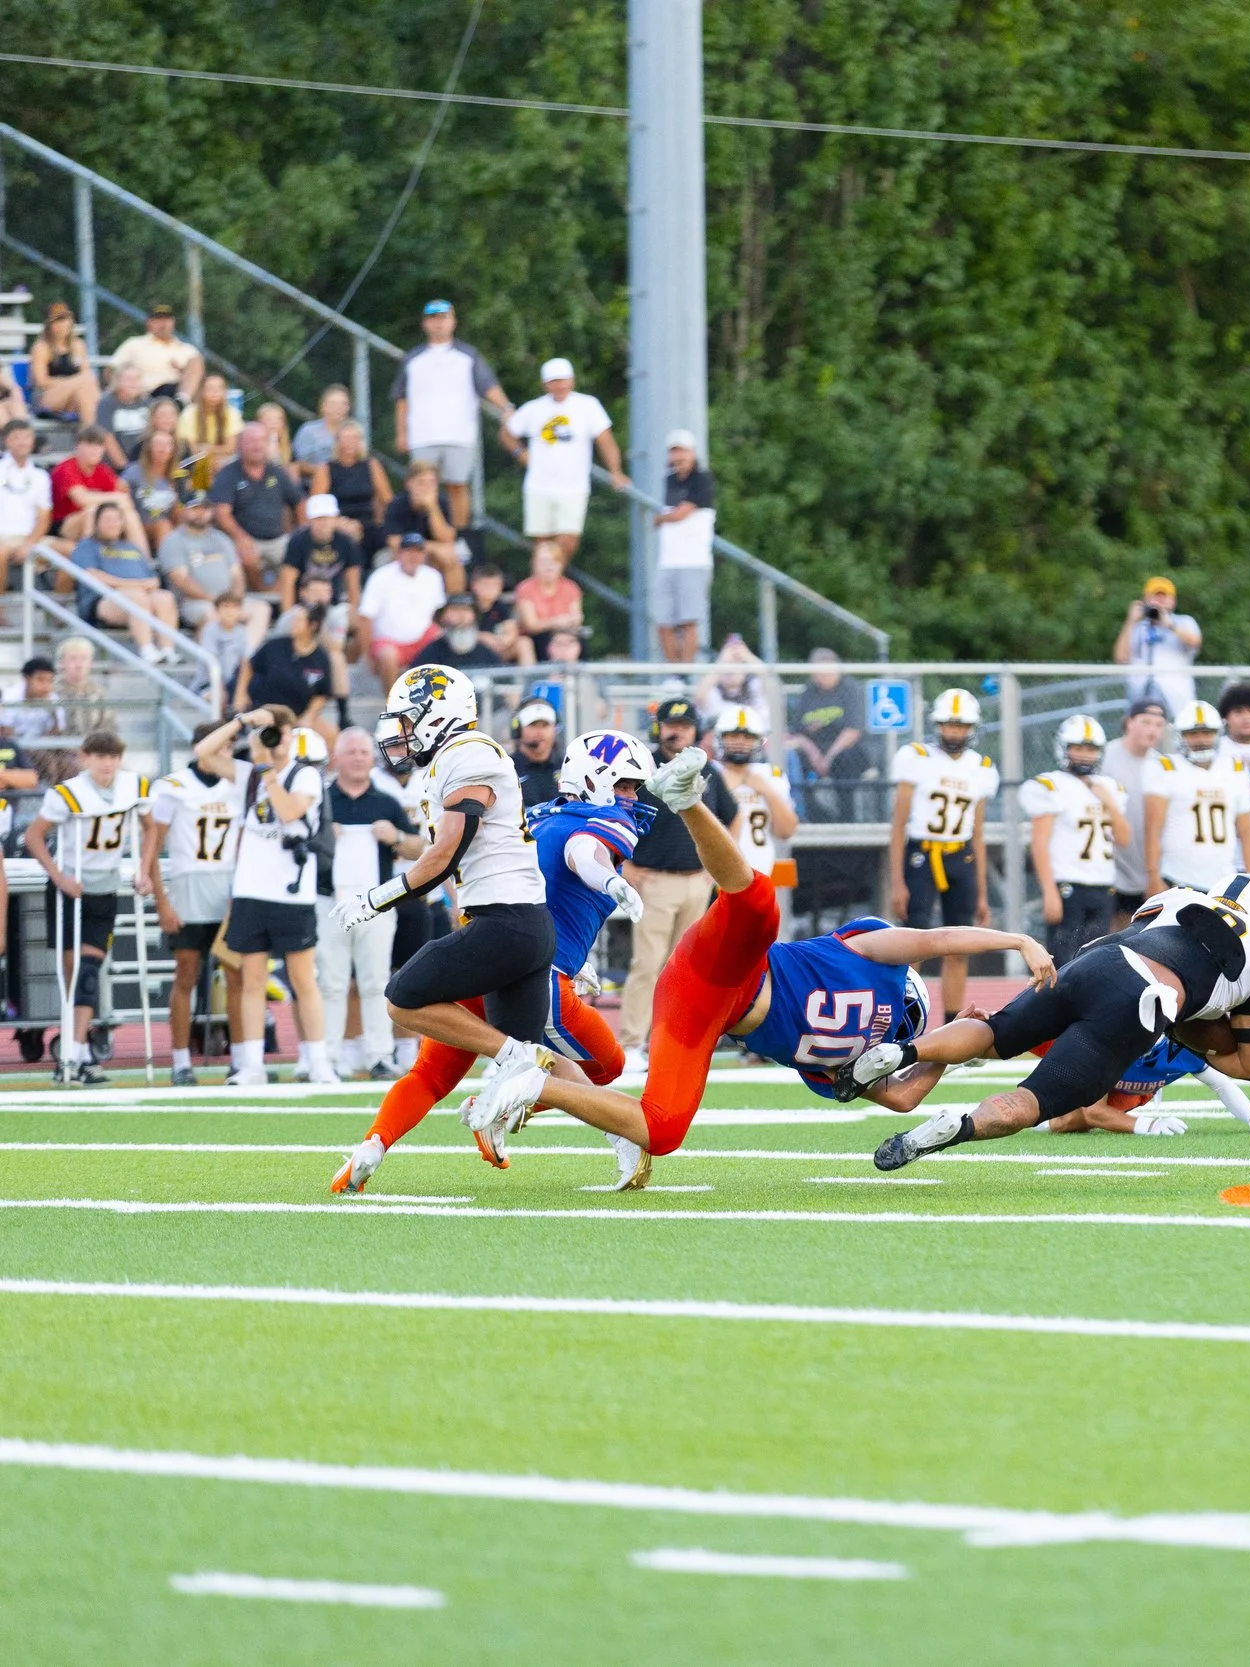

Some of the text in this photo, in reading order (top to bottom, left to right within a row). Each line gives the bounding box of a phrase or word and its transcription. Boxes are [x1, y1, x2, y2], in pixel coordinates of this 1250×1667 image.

[588, 733, 628, 766] N
[86, 812, 125, 849] 13
[927, 792, 971, 835] 37
[1191, 803, 1226, 843] 10
[196, 816, 232, 860] 17
[793, 988, 875, 1067] 50
[866, 1004, 892, 1051] BRUIN
